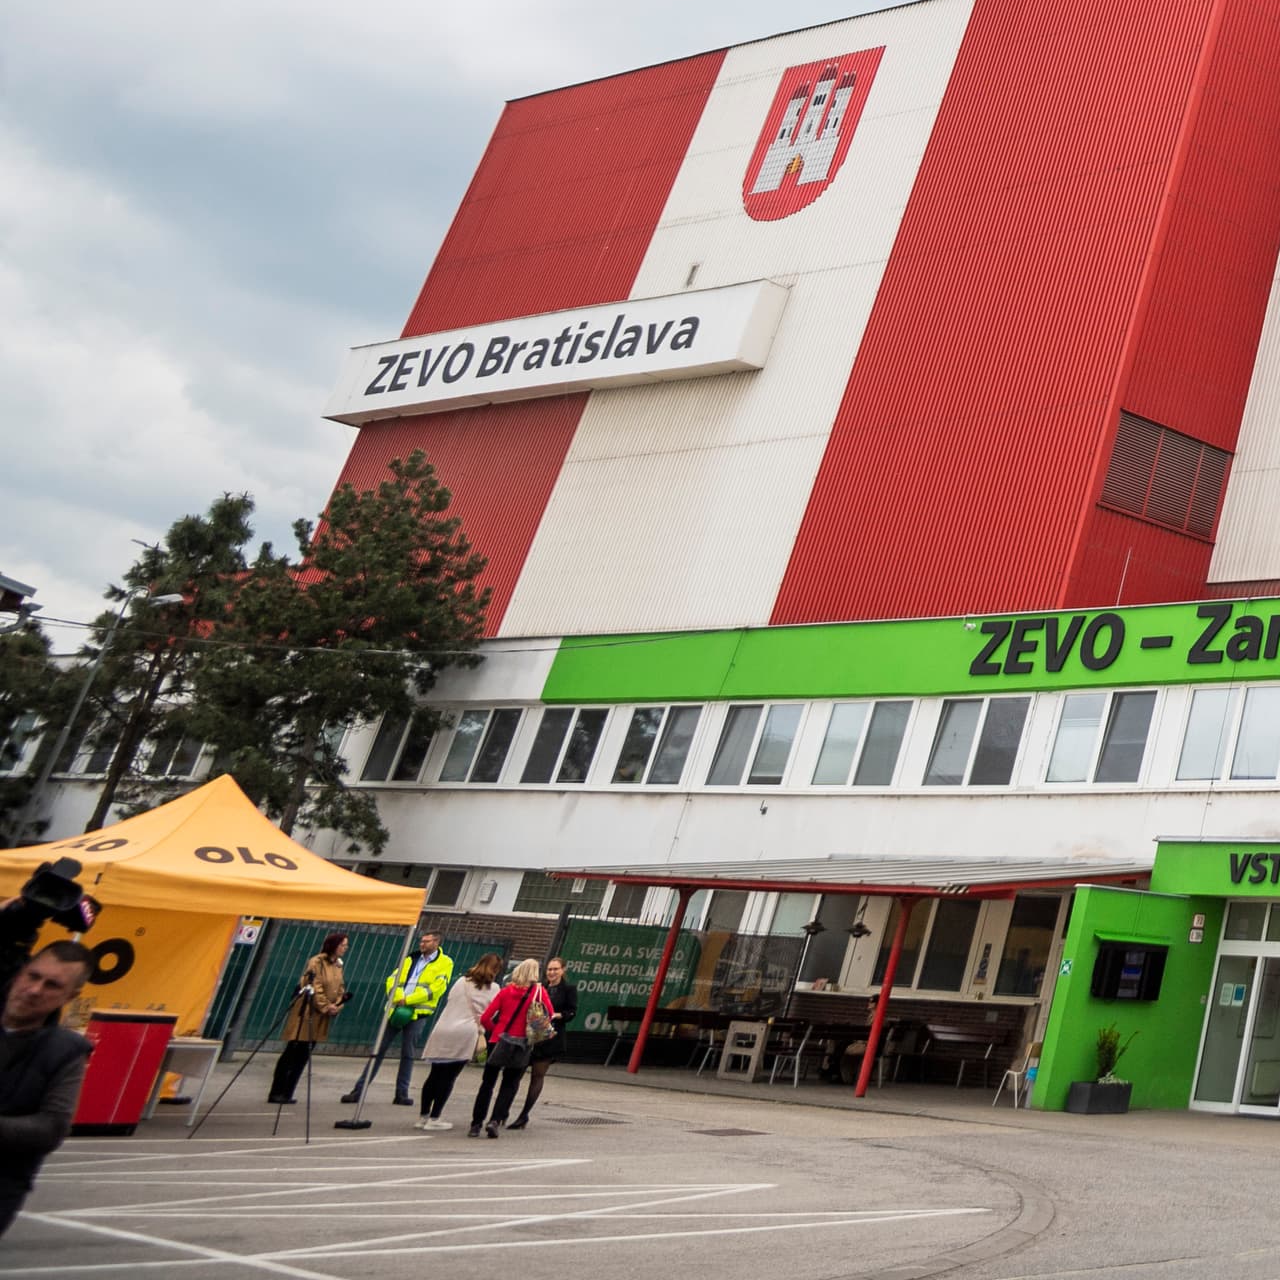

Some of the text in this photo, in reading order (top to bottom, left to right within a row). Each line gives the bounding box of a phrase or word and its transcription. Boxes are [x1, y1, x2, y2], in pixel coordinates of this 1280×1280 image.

[364, 314, 700, 396] ZEVO Bratislava
[968, 611, 1126, 677] ZEVO
[194, 846, 298, 871] OLO
[580, 942, 685, 961] TEPLO A SVEO
[566, 960, 689, 979] PRE BRATISLAKÉ
[576, 979, 667, 998] DOMÁCNOSI
[585, 1012, 629, 1031] OL
